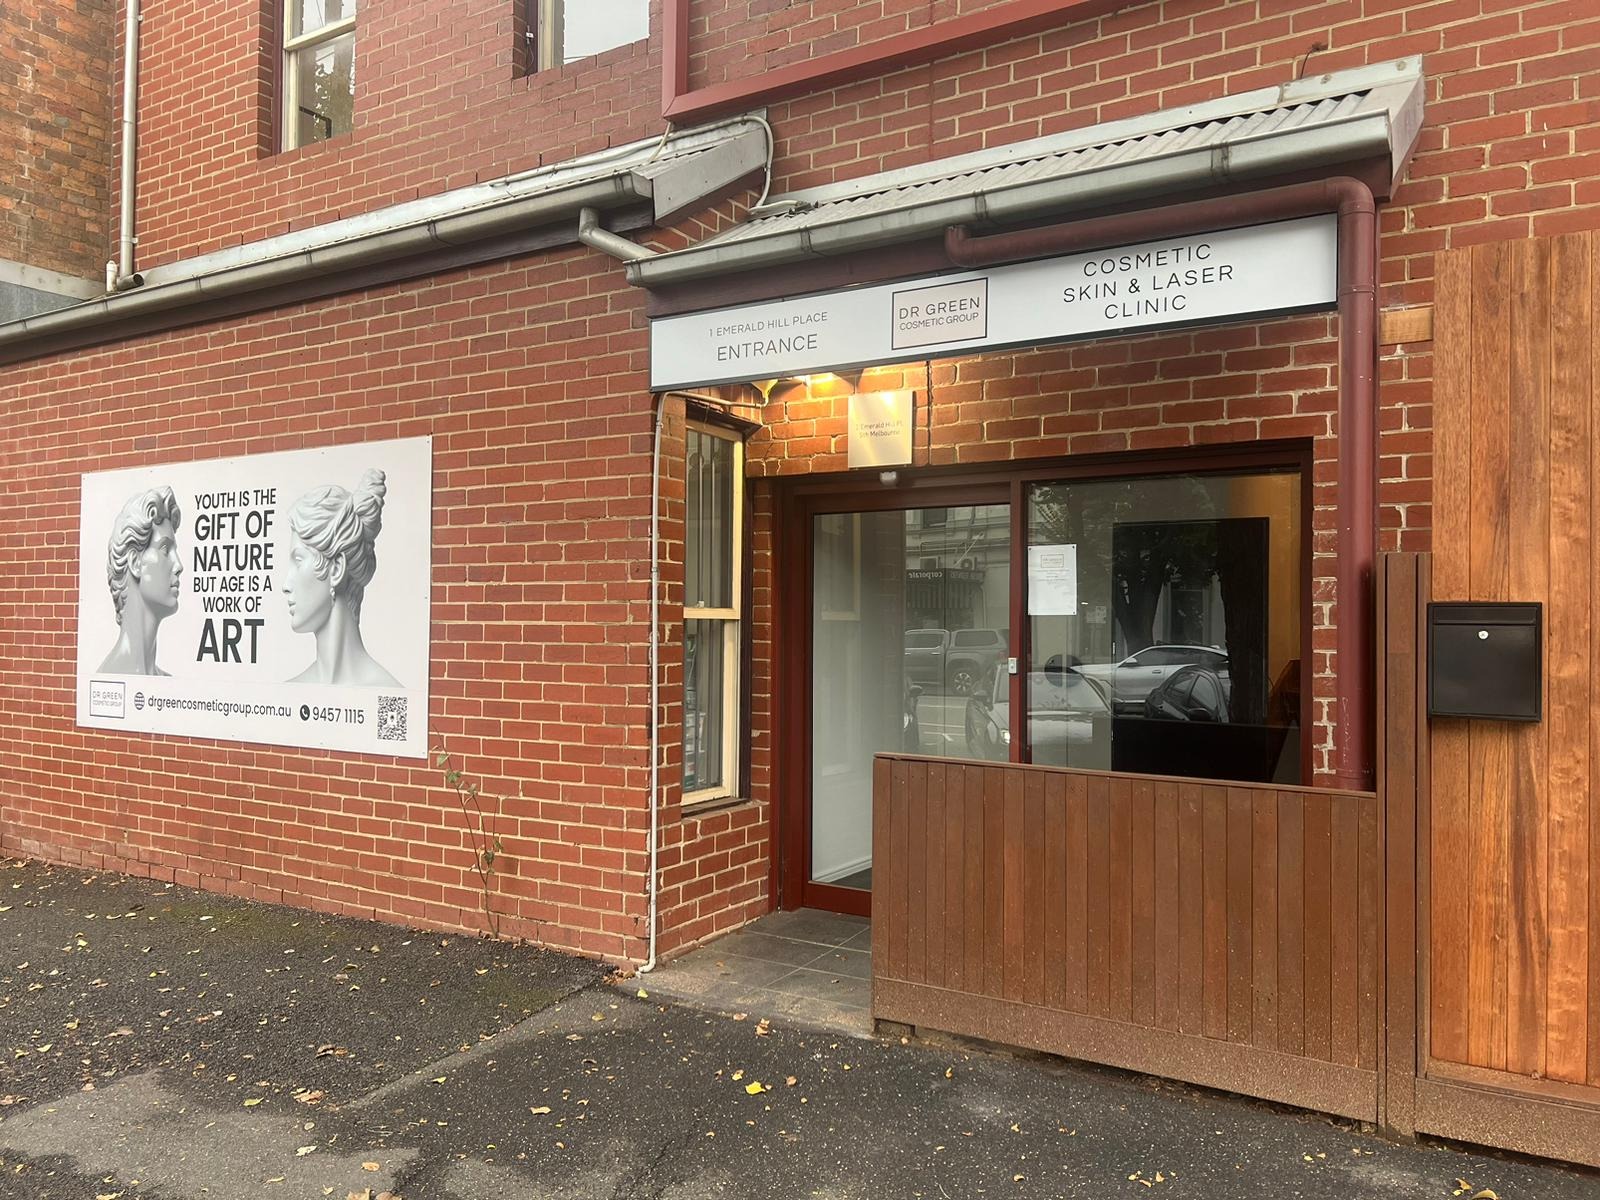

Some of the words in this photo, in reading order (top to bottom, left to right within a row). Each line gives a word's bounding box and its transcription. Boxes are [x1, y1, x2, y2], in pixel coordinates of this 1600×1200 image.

[1083, 243, 1211, 277] COSMETIC
[1063, 281, 1117, 303] SKIN
[1128, 278, 1141, 294] &
[1153, 264, 1233, 291] LASER
[899, 306, 920, 320] DR
[925, 296, 980, 316] GREEN
[1104, 294, 1187, 320] CLINIC
[716, 321, 765, 337] EMERALD
[767, 318, 789, 329] HILL
[792, 311, 828, 326] PLACE
[899, 317, 944, 331] COSMETIC
[945, 312, 979, 324] GROUP
[717, 333, 818, 361] ENTRANCE
[861, 421, 885, 430] Emerald
[869, 429, 901, 438] Melbourne
[194, 491, 236, 510] YOUTH
[239, 490, 250, 507] IS
[253, 488, 277, 506] THE
[194, 512, 240, 541] GIFT
[245, 509, 275, 538] OF
[193, 543, 274, 572] NATURE
[193, 576, 217, 593] BUT
[219, 576, 245, 592] AGE
[248, 575, 260, 592] IS
[262, 575, 273, 592] A
[202, 596, 242, 613] WORK
[244, 596, 262, 613] OF
[196, 618, 265, 664] ART
[102, 691, 123, 701] GREEN
[147, 695, 292, 718] drgreencosmeticgroup.com.au
[312, 706, 341, 722] 9457
[344, 708, 365, 724] 1115
